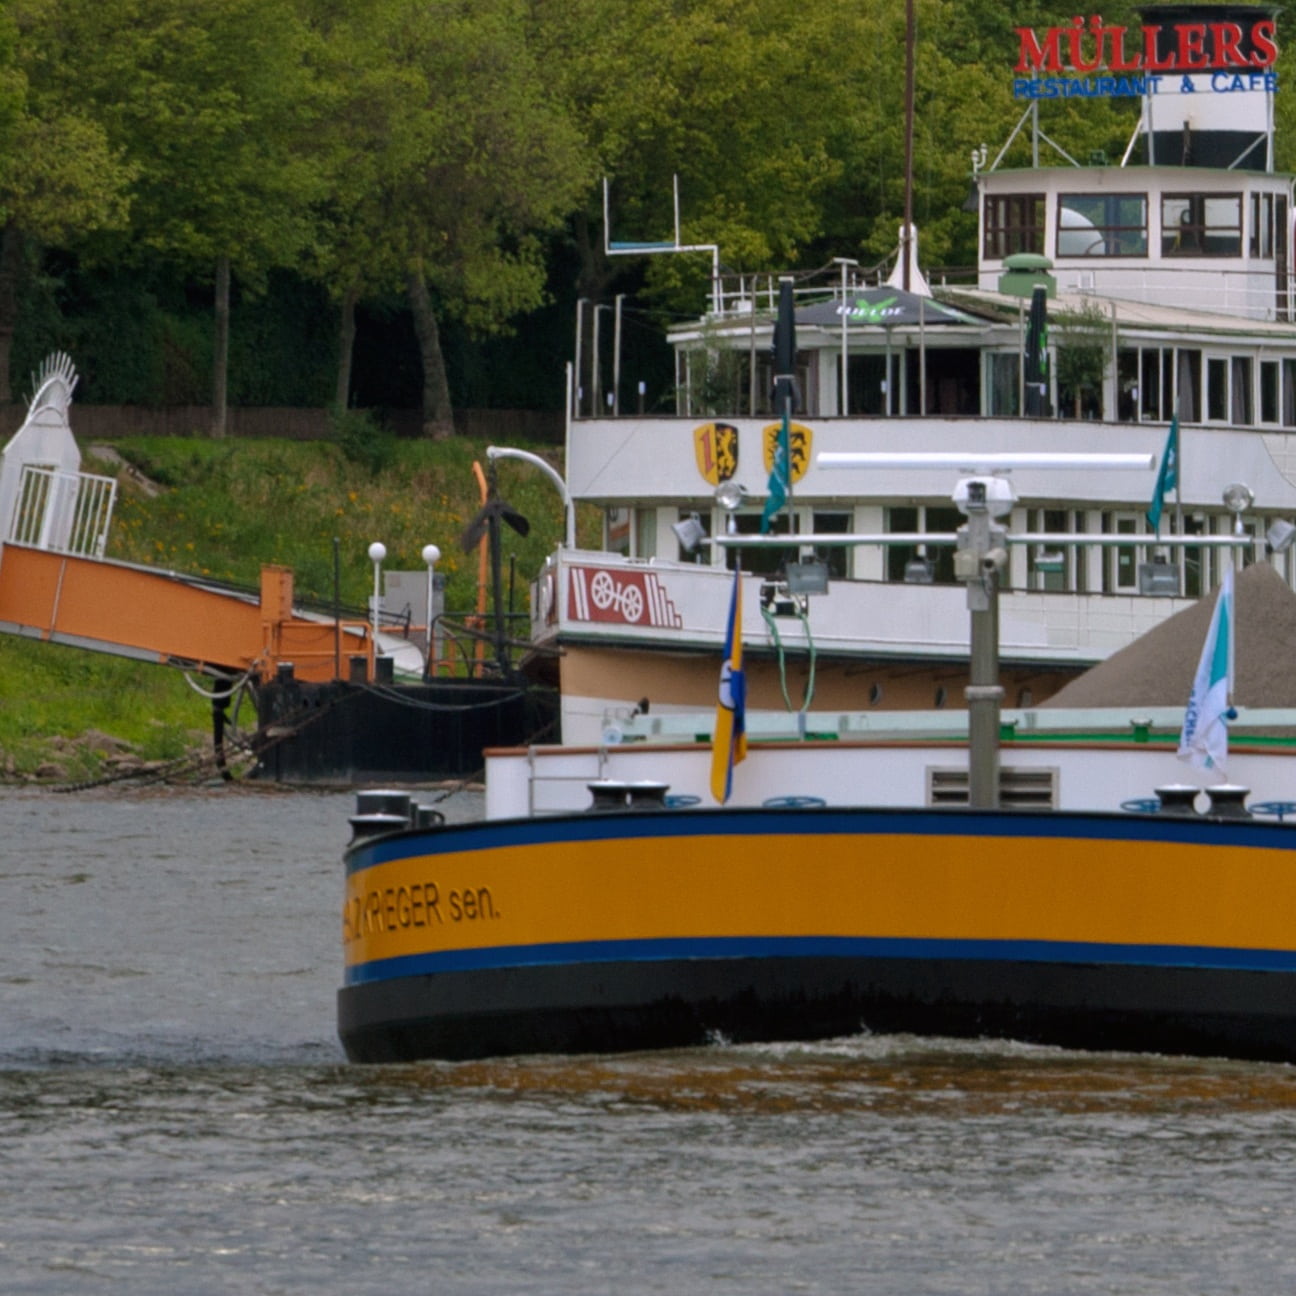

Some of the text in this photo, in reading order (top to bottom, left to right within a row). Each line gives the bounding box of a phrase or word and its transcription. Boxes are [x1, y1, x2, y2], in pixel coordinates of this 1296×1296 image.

[1013, 14, 1279, 72] MÜLLERS
[1013, 76, 1163, 99] RESTAURANT
[1180, 74, 1195, 94] &
[449, 885, 500, 922] sen.
